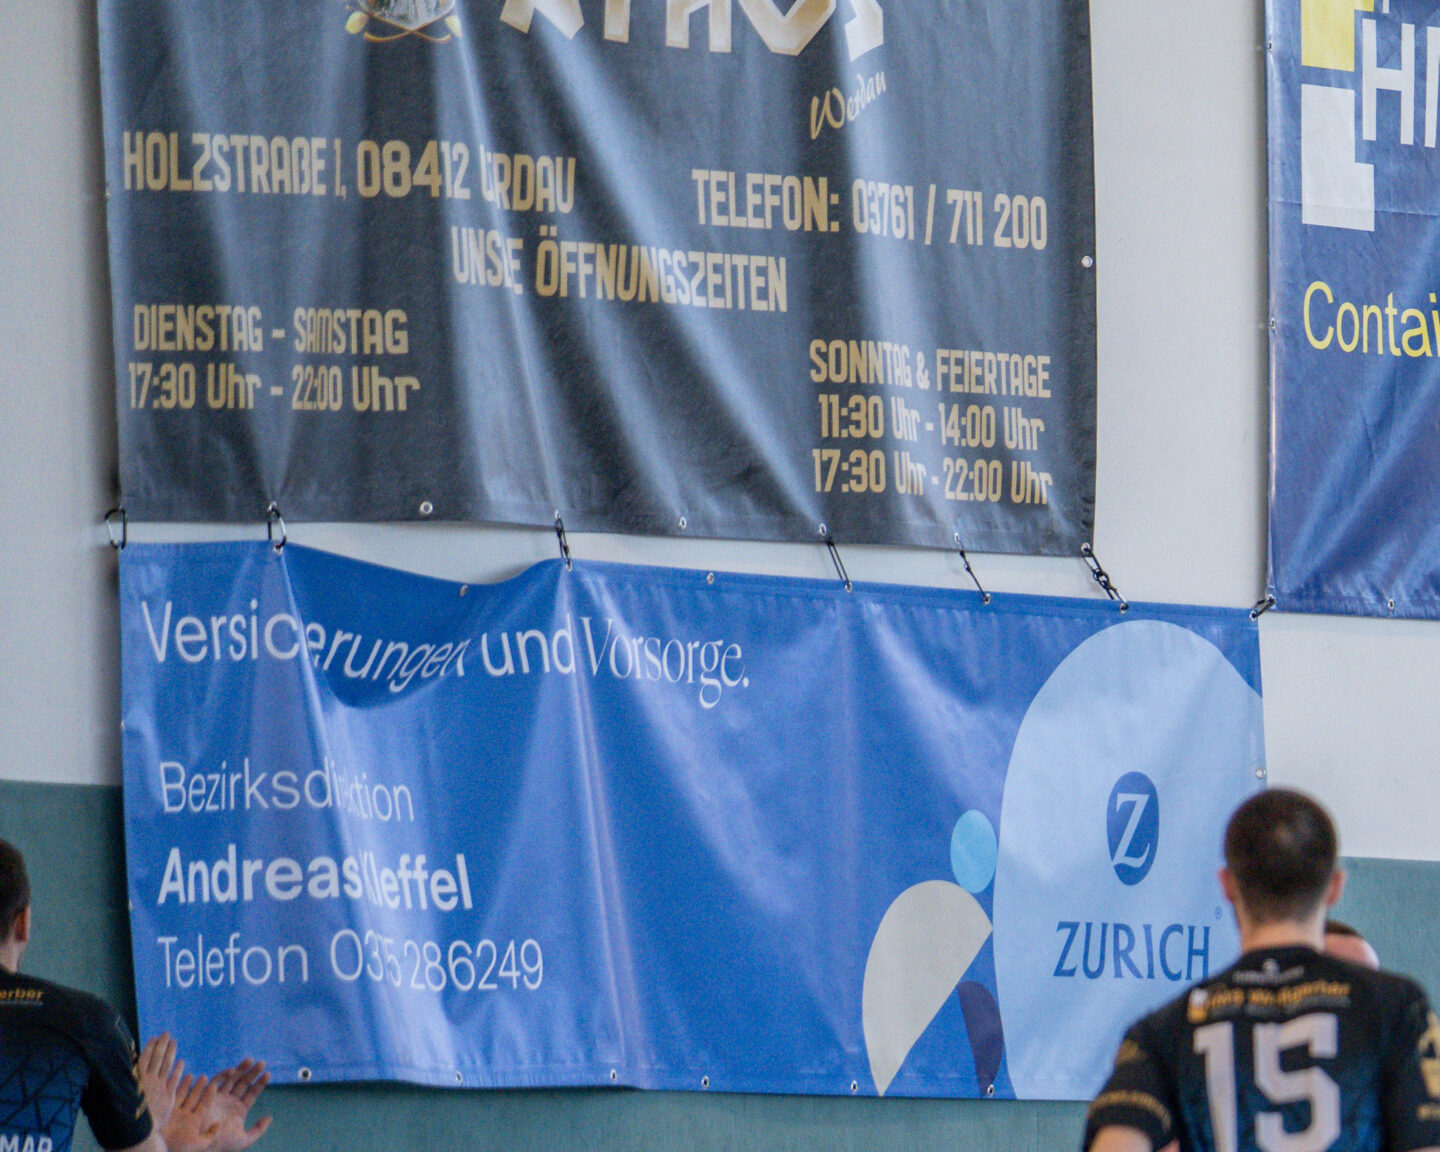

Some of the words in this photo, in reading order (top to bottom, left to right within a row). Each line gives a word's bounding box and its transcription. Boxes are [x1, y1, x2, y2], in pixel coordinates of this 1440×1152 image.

[357, 140, 471, 199] 08412
[692, 169, 840, 232] TELEFON:
[852, 179, 914, 240] 03761
[947, 190, 983, 245] 711
[994, 194, 1048, 250] 200
[536, 225, 787, 312] ÖFFNUNGSZEITEN
[134, 304, 263, 352] DIENSTAG
[294, 308, 408, 354] SAMSTAG
[129, 362, 196, 409] 17:30
[207, 363, 262, 409] Uhr
[292, 365, 342, 410] 22:00
[353, 366, 420, 411] Uhr
[809, 339, 912, 389] SONNTAG
[936, 349, 1051, 398] FEIERTAGE
[819, 394, 884, 439] 11:30
[892, 397, 921, 443] Uhr
[938, 403, 995, 449] 14:00
[1004, 407, 1045, 451] Uhr
[812, 449, 886, 494] 17:30
[894, 454, 926, 496] Uhr
[943, 458, 1001, 502] 22:00
[1011, 461, 1053, 505] Uhr
[482, 613, 575, 676] und
[581, 615, 750, 709] Vorsorge.
[157, 843, 363, 905] Andreas
[157, 932, 309, 989] Telefon
[1052, 920, 1211, 982] ZURICH
